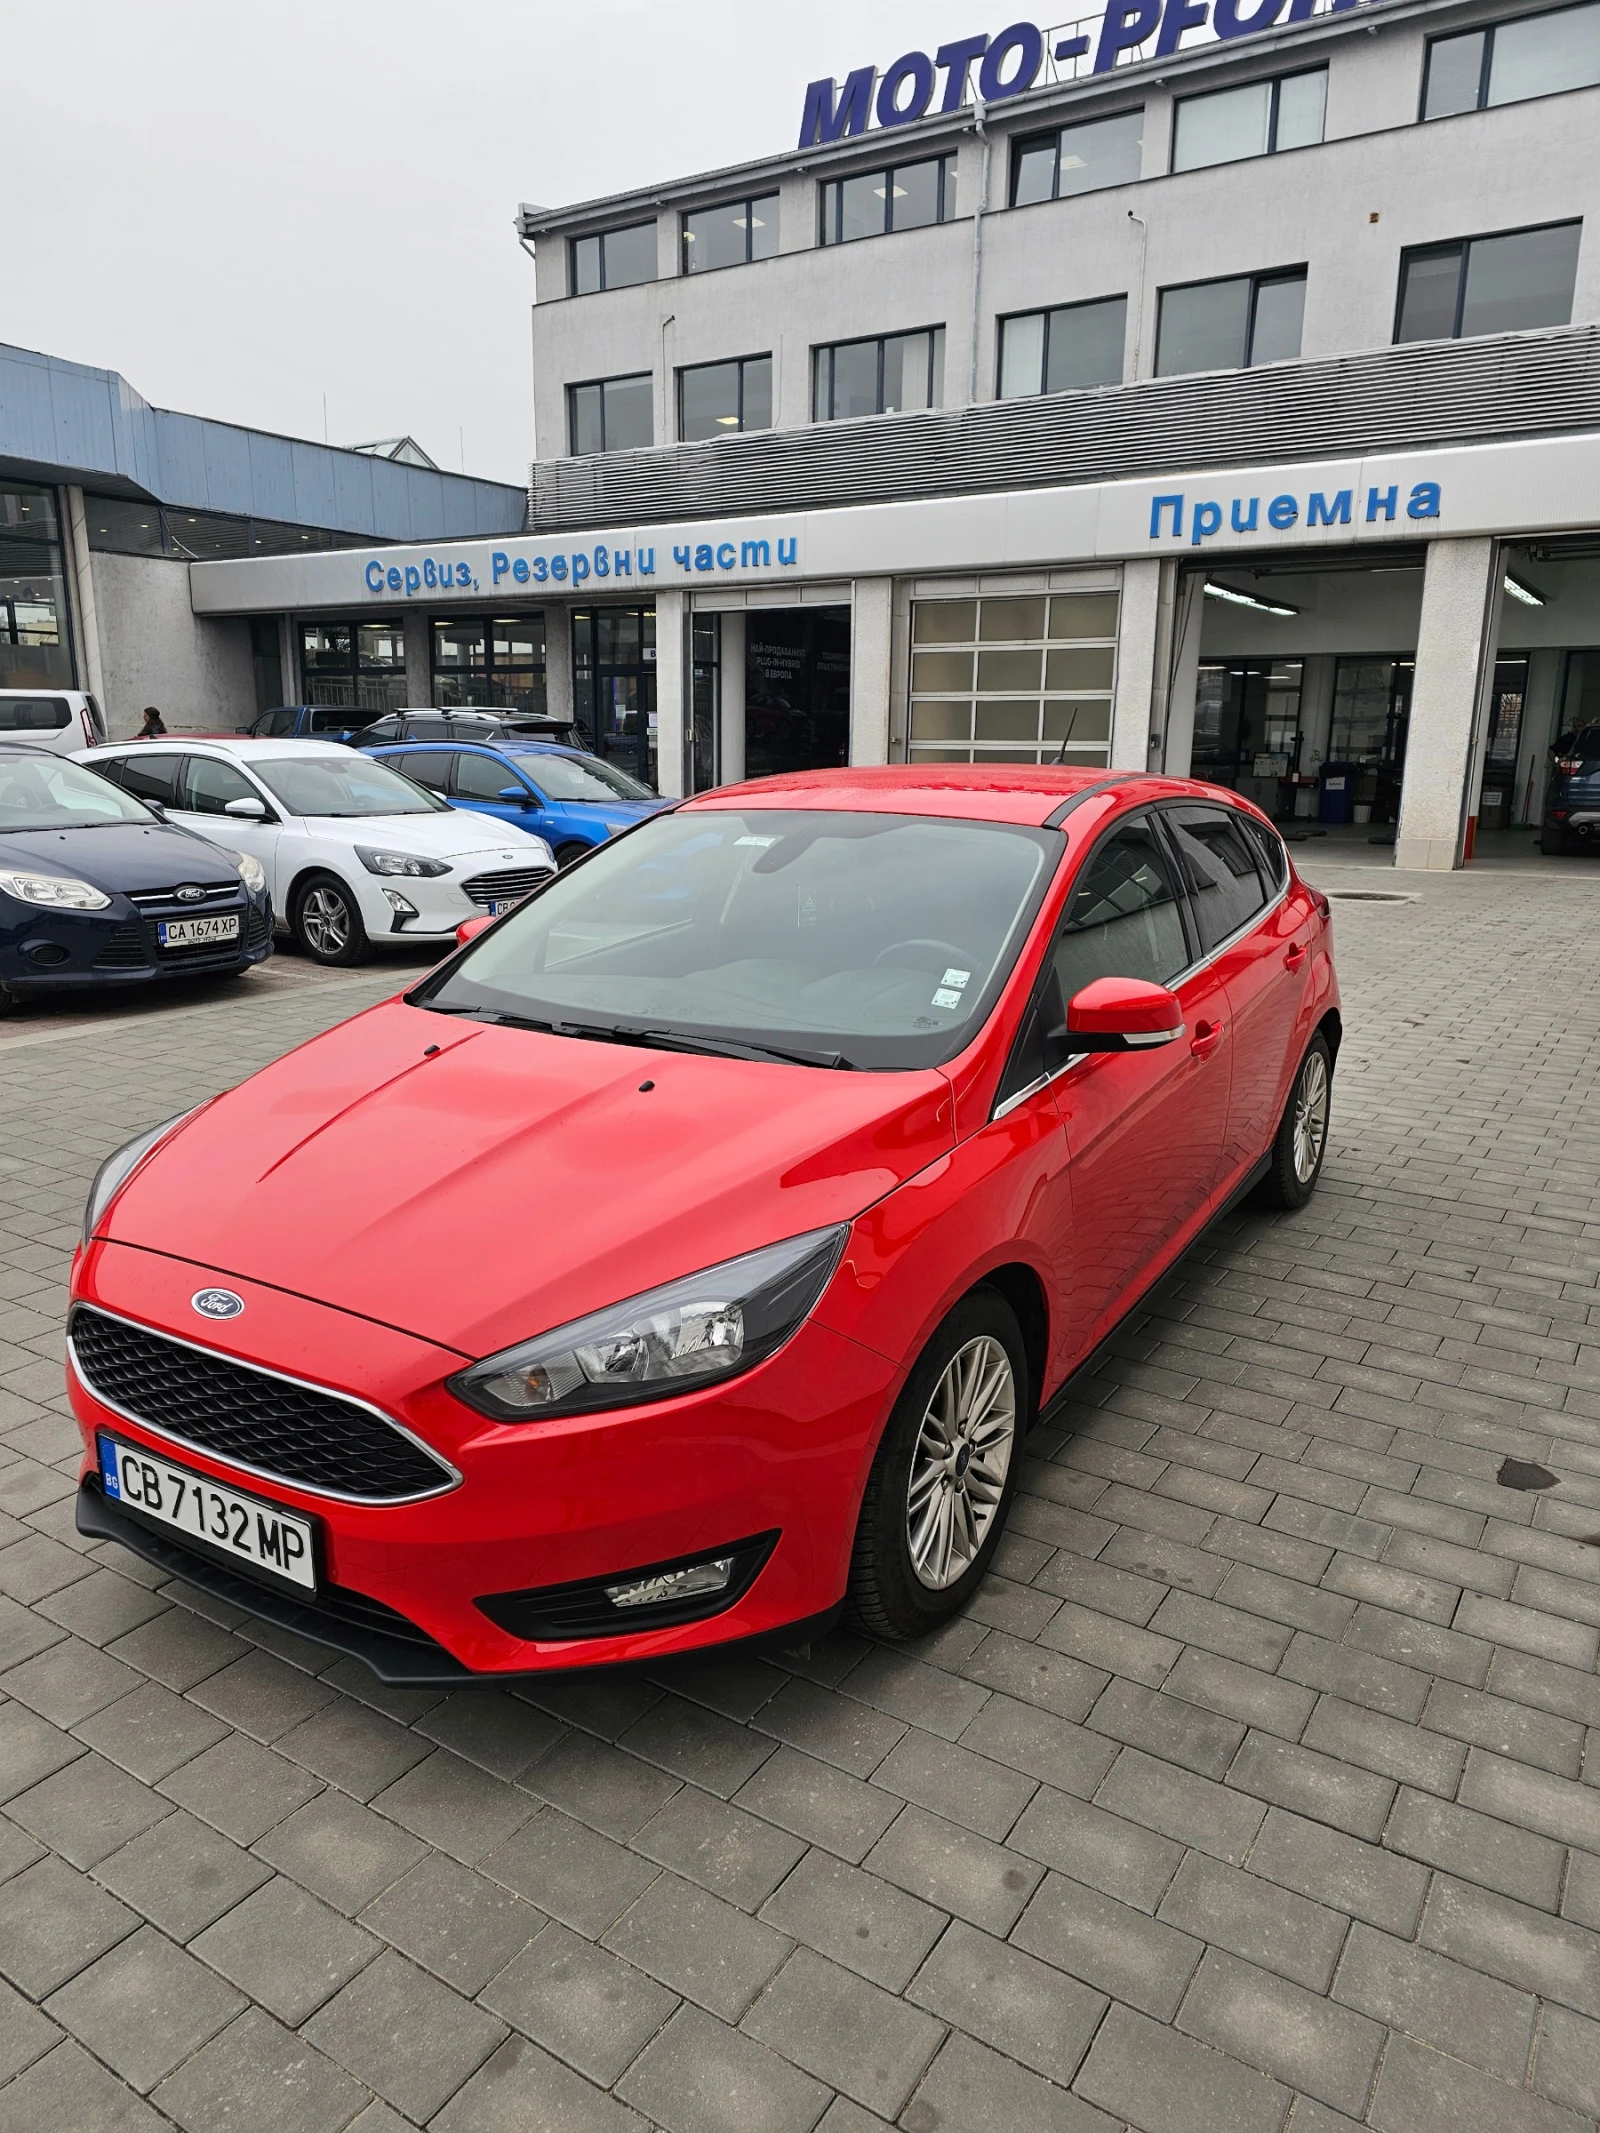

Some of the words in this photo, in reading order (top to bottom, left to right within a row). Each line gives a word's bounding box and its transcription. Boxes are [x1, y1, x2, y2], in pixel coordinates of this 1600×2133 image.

[1150, 482, 1442, 545] Приемна
[365, 559, 480, 596] Сервиз,
[492, 546, 656, 587] Резервни
[673, 536, 798, 571] части
[770, 669, 792, 680] ЕВРОПА
[168, 924, 186, 939] CA
[190, 920, 219, 937] 1674
[221, 918, 237, 933] XP
[200, 1293, 234, 1313] Ford
[105, 1472, 119, 1489] BG
